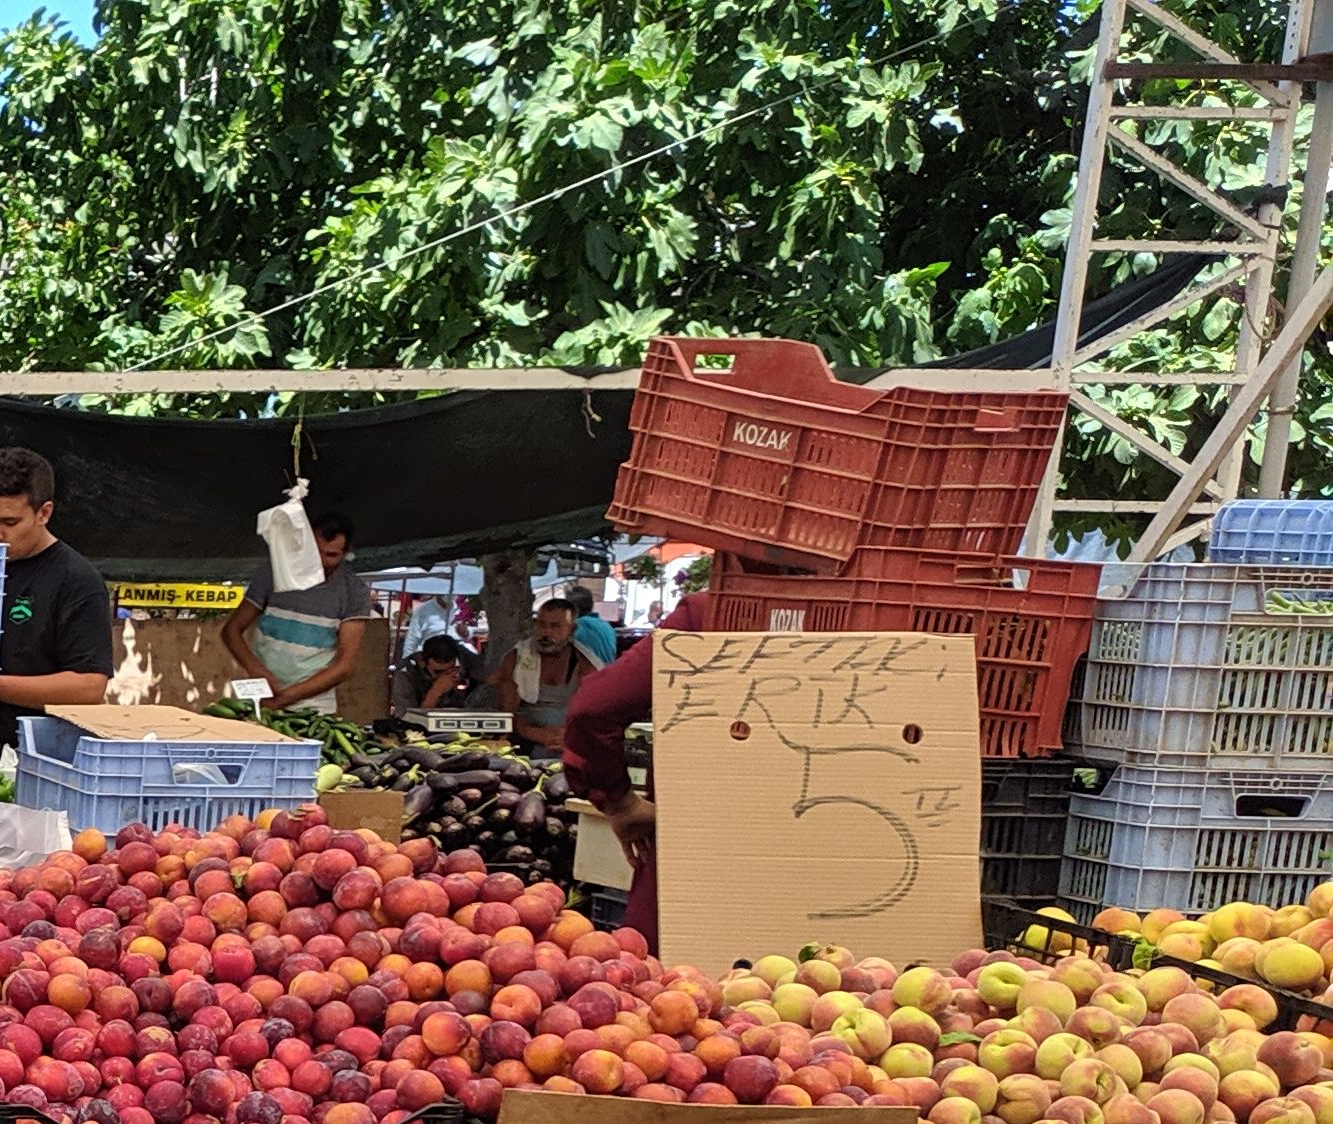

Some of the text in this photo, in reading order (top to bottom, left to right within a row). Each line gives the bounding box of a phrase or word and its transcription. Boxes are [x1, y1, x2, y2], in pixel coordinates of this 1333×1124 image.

[732, 421, 793, 451] KOZAK
[184, 590, 237, 603] KEBAP
[769, 608, 807, 632] KOZAK
[791, 740, 921, 920] 5
